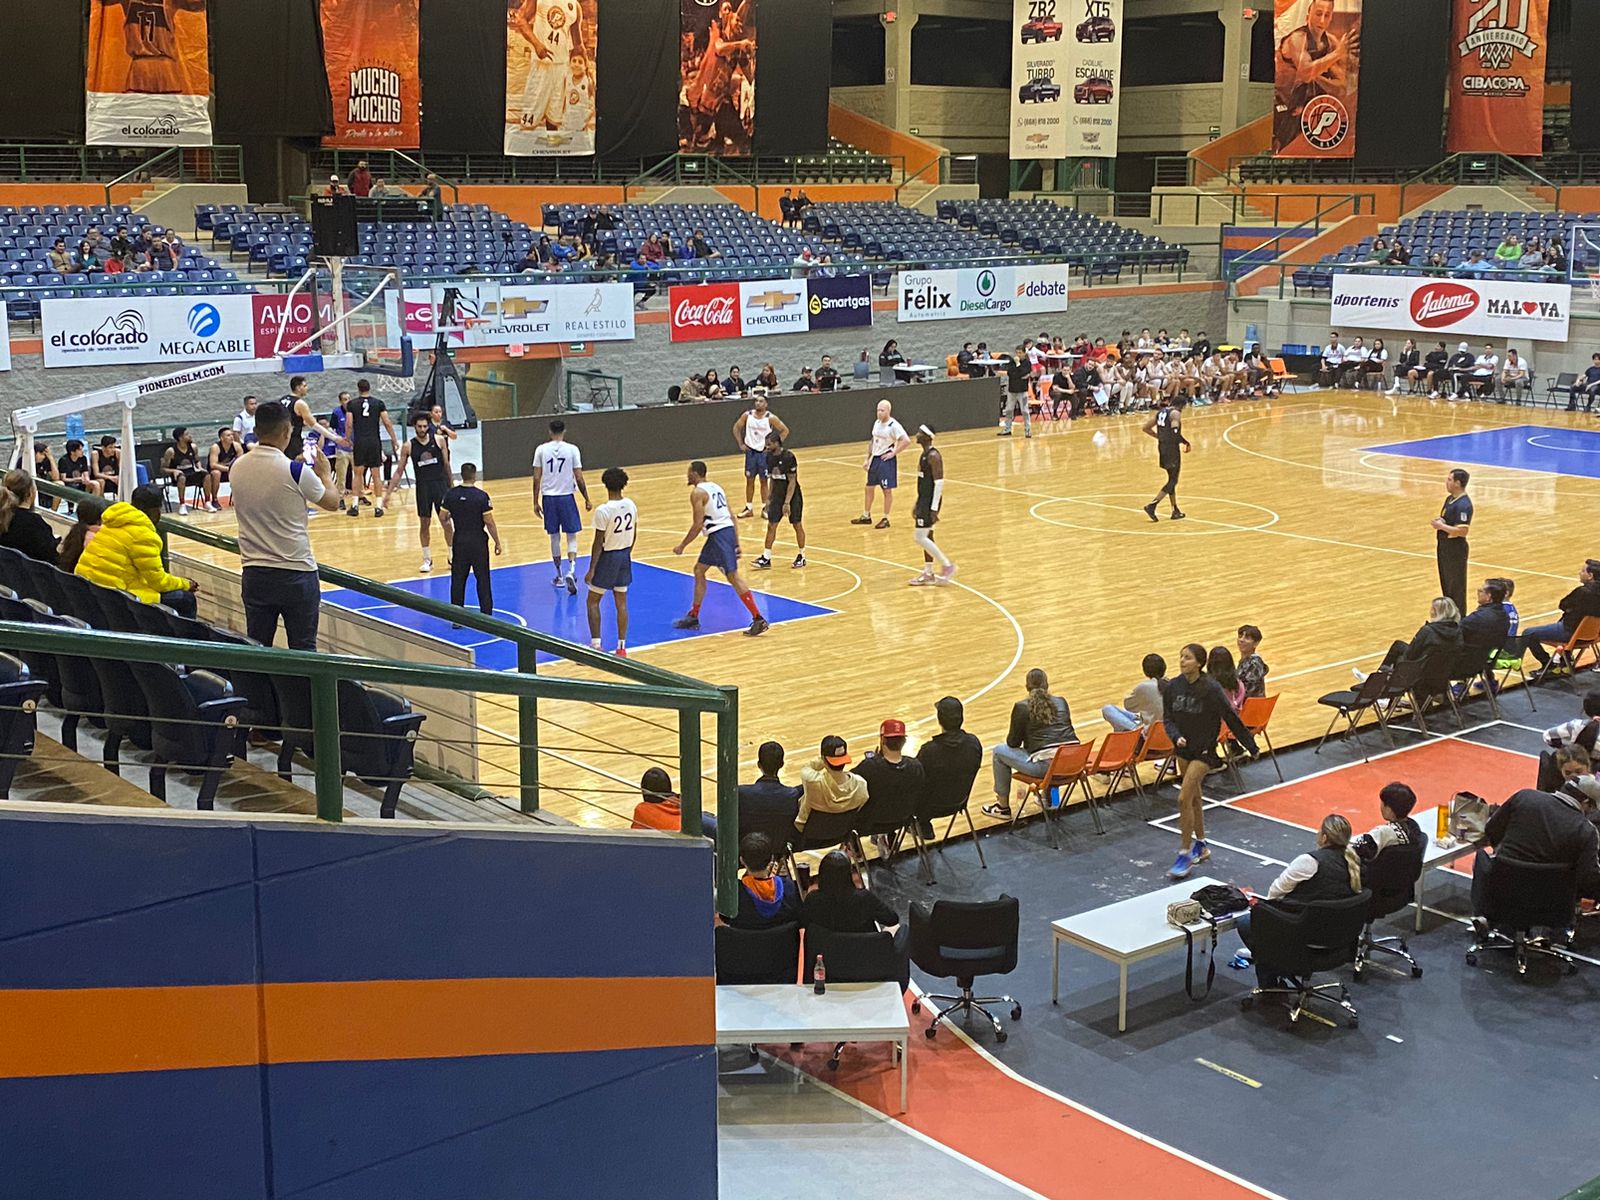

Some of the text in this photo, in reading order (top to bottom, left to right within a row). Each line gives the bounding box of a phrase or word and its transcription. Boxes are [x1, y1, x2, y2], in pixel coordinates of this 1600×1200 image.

[1028, 1, 1056, 19] ZR2
[1085, 0, 1110, 18] XT5
[547, 31, 560, 46] 44
[1026, 67, 1055, 79] TURBO
[1075, 68, 1114, 80] ESCALADE
[350, 67, 399, 98] MUCHO
[1462, 76, 1525, 90] CIBACOPA
[348, 95, 401, 123] MOCHIS
[522, 113, 534, 126] 44
[121, 125, 180, 135] el colorado
[904, 274, 933, 287] Grupo
[1026, 281, 1066, 297] debate
[822, 296, 870, 310] Smartgas
[904, 286, 952, 310] Félix
[960, 298, 1011, 312] DieselCargo
[1333, 293, 1401, 308] dportenis
[1415, 290, 1474, 321] Jaloma
[674, 297, 736, 328] Coca-Cola
[746, 314, 803, 325] CHEVROLET
[297, 326, 308, 334] DE
[565, 319, 627, 331] REAL ESTILO
[50, 328, 148, 346] el colorado
[159, 339, 251, 355] MEGACABLE
[138, 365, 226, 394] PIONEROSLM.COM
[362, 403, 370, 417] 2
[546, 457, 566, 473] 17
[613, 512, 633, 534] 22
